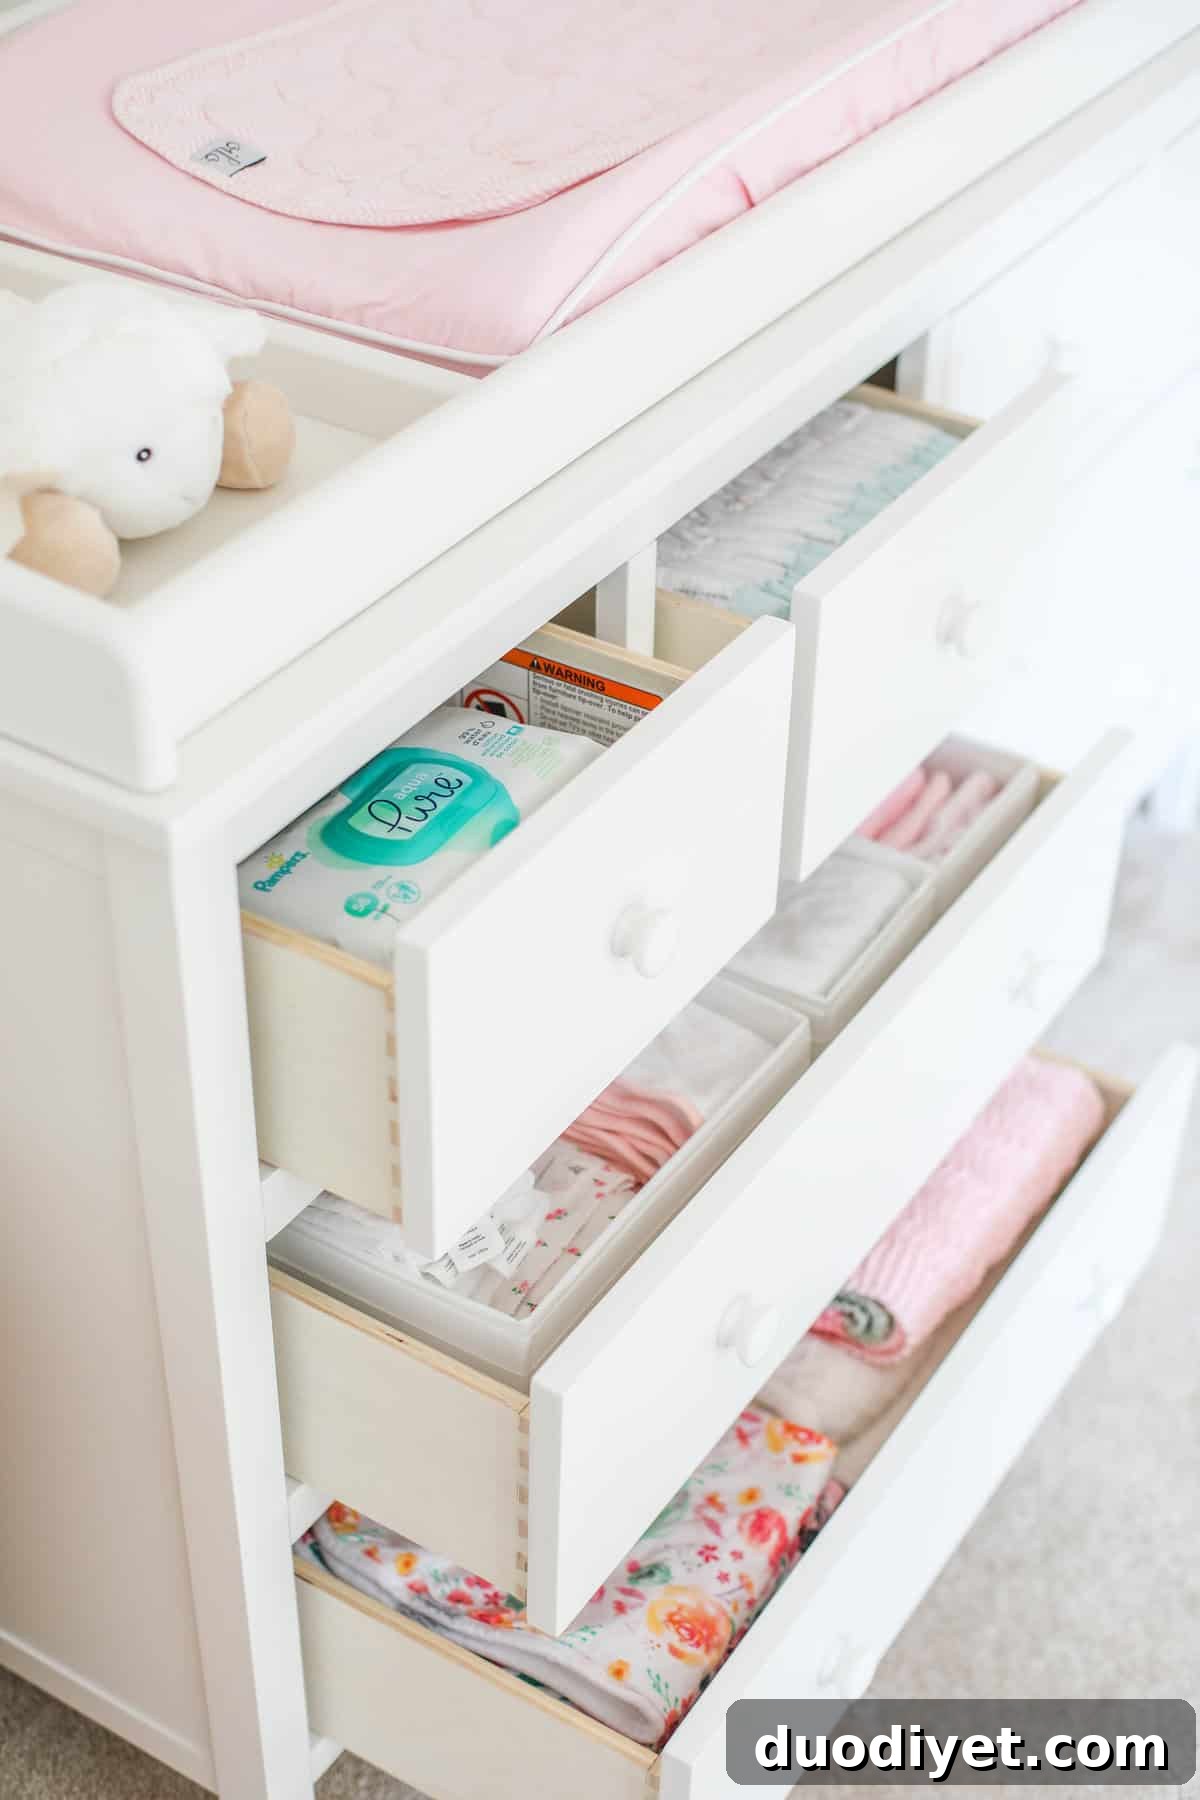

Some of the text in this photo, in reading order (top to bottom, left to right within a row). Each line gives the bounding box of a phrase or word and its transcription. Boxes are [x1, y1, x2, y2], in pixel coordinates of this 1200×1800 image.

[543, 661, 606, 692] WARNING
[367, 777, 463, 833] Pure
[393, 773, 428, 801] aqua
[252, 851, 306, 892] Pampers
